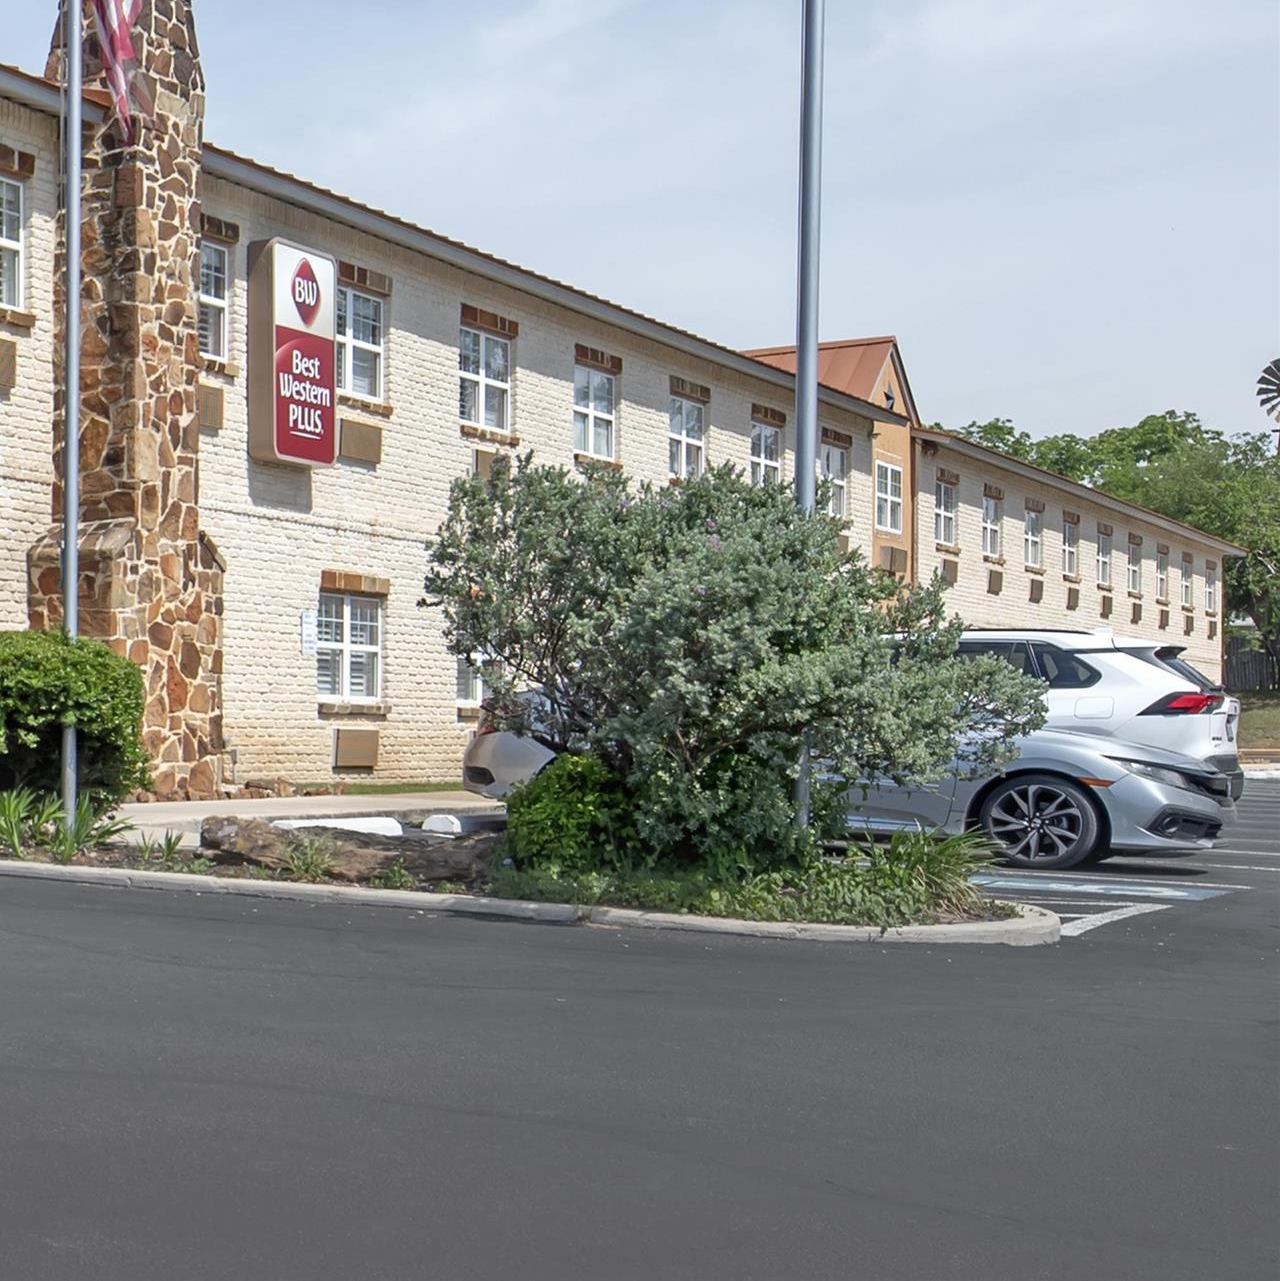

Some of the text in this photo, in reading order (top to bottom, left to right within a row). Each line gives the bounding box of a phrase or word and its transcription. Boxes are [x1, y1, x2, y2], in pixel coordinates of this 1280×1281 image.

[295, 276, 317, 306] BW
[292, 349, 320, 379] Best
[279, 372, 331, 407] Western
[289, 403, 323, 434] PLUS
